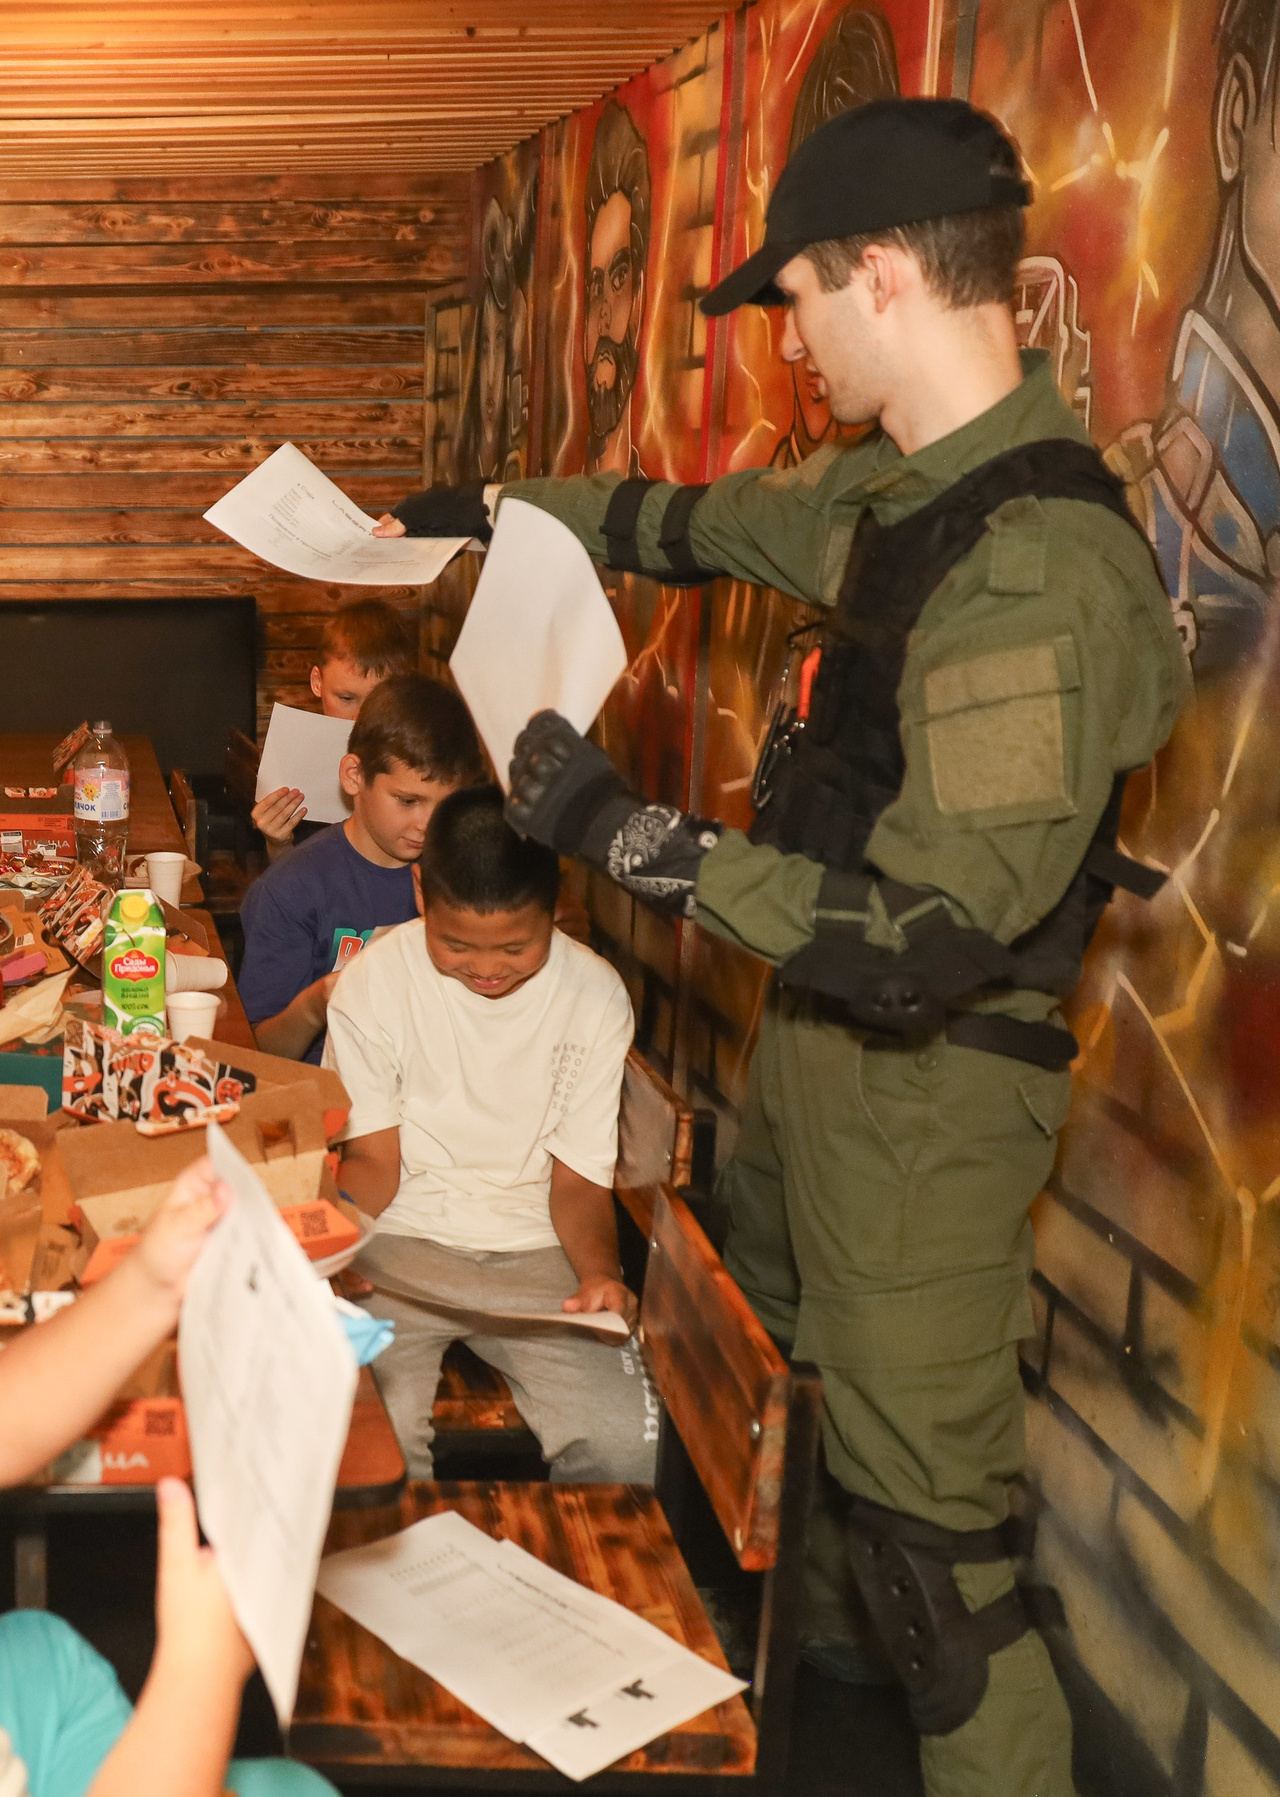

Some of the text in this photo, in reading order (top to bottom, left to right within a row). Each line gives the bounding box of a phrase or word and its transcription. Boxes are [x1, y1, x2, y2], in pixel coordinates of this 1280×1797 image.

[74, 802, 96, 812] ЯЧОК
[123, 957, 147, 966] Сады
[114, 963, 156, 975] Придонья
